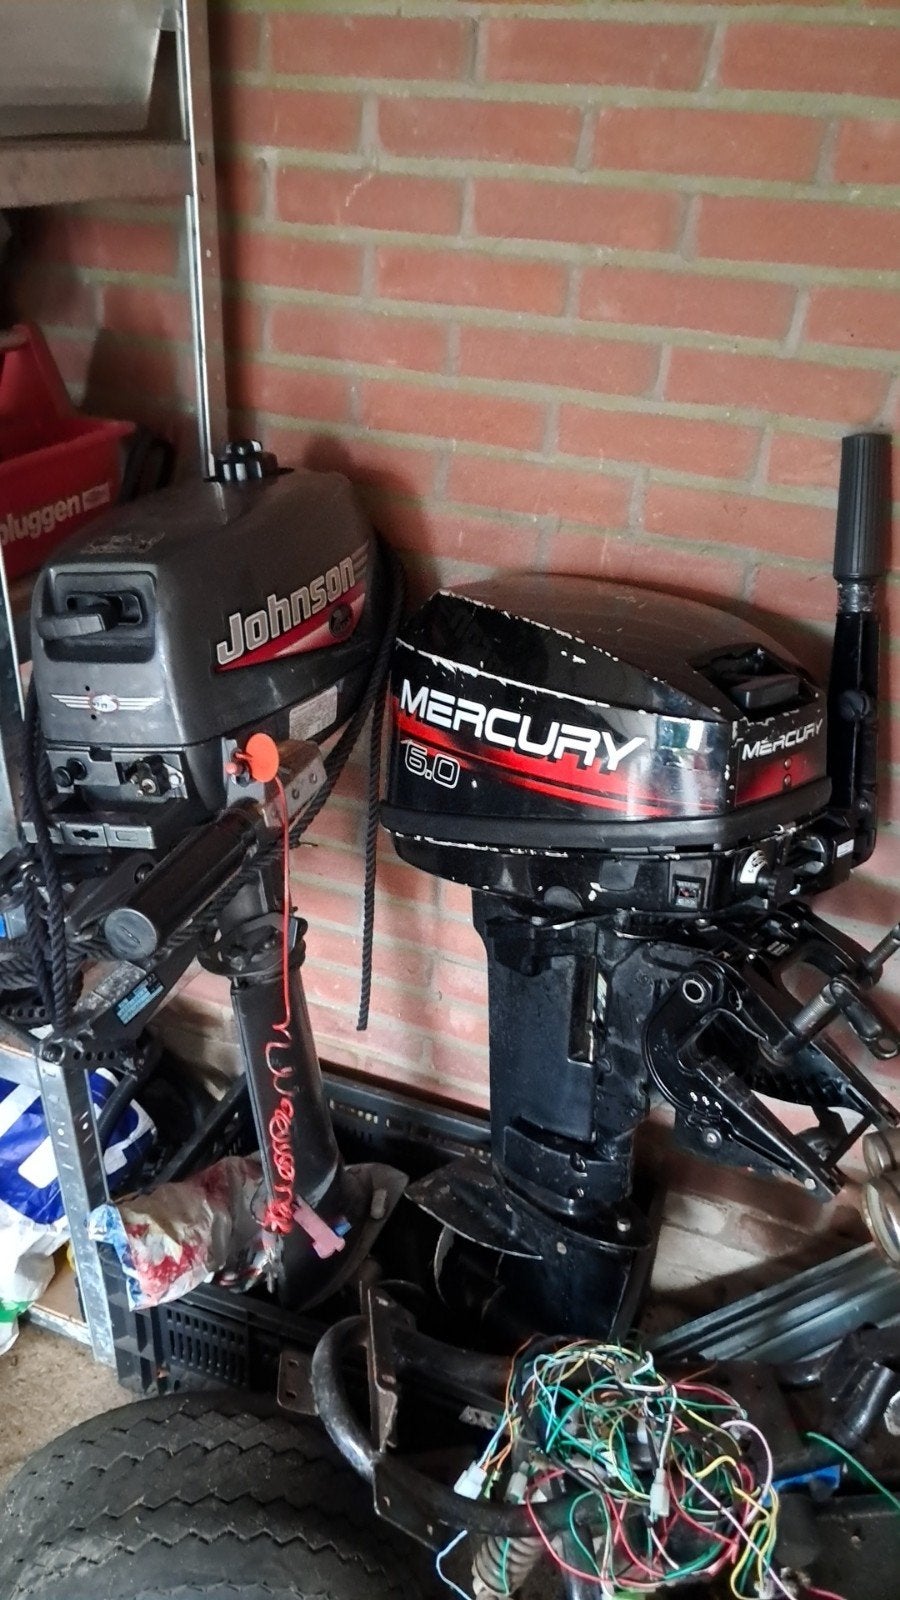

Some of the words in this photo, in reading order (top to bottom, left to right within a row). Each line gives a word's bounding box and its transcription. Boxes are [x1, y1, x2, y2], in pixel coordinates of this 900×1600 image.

[216, 556, 356, 665] Johnson
[400, 679, 647, 771] MERCURY
[742, 718, 823, 761] MERCURY
[404, 740, 460, 790] 6.0
